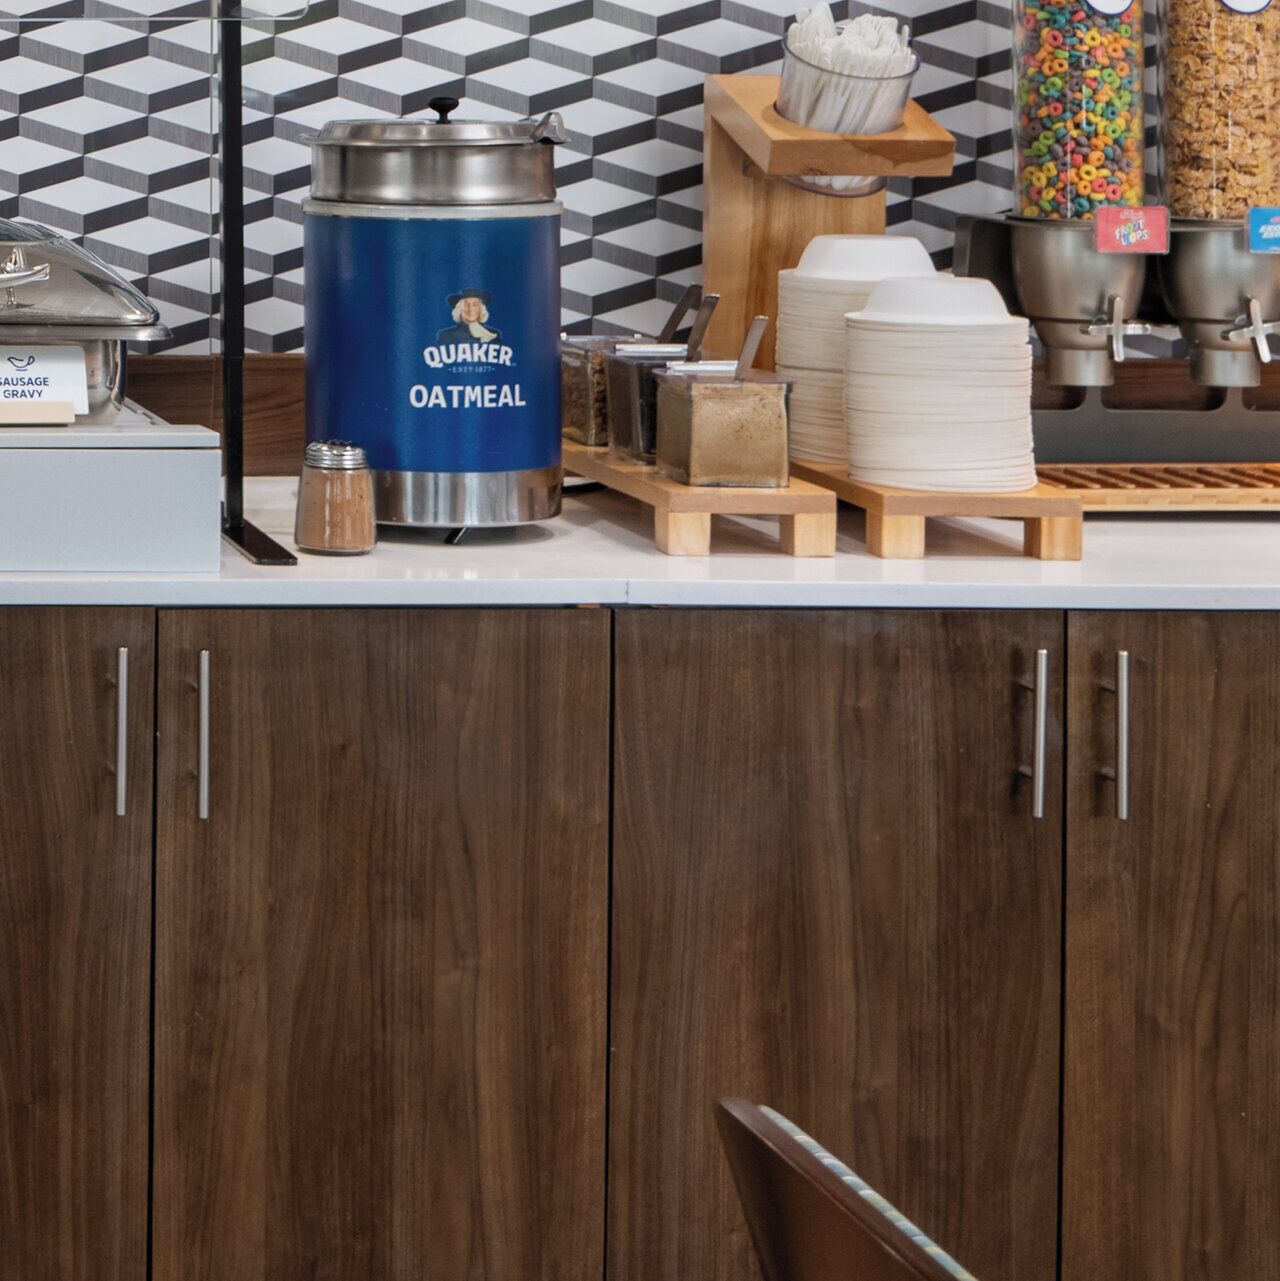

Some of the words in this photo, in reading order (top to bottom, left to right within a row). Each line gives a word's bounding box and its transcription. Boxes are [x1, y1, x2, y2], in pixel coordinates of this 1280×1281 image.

[423, 343, 514, 369] QUAKER
[2, 389, 44, 399] GRAVY
[409, 384, 527, 409] OATMEAL
